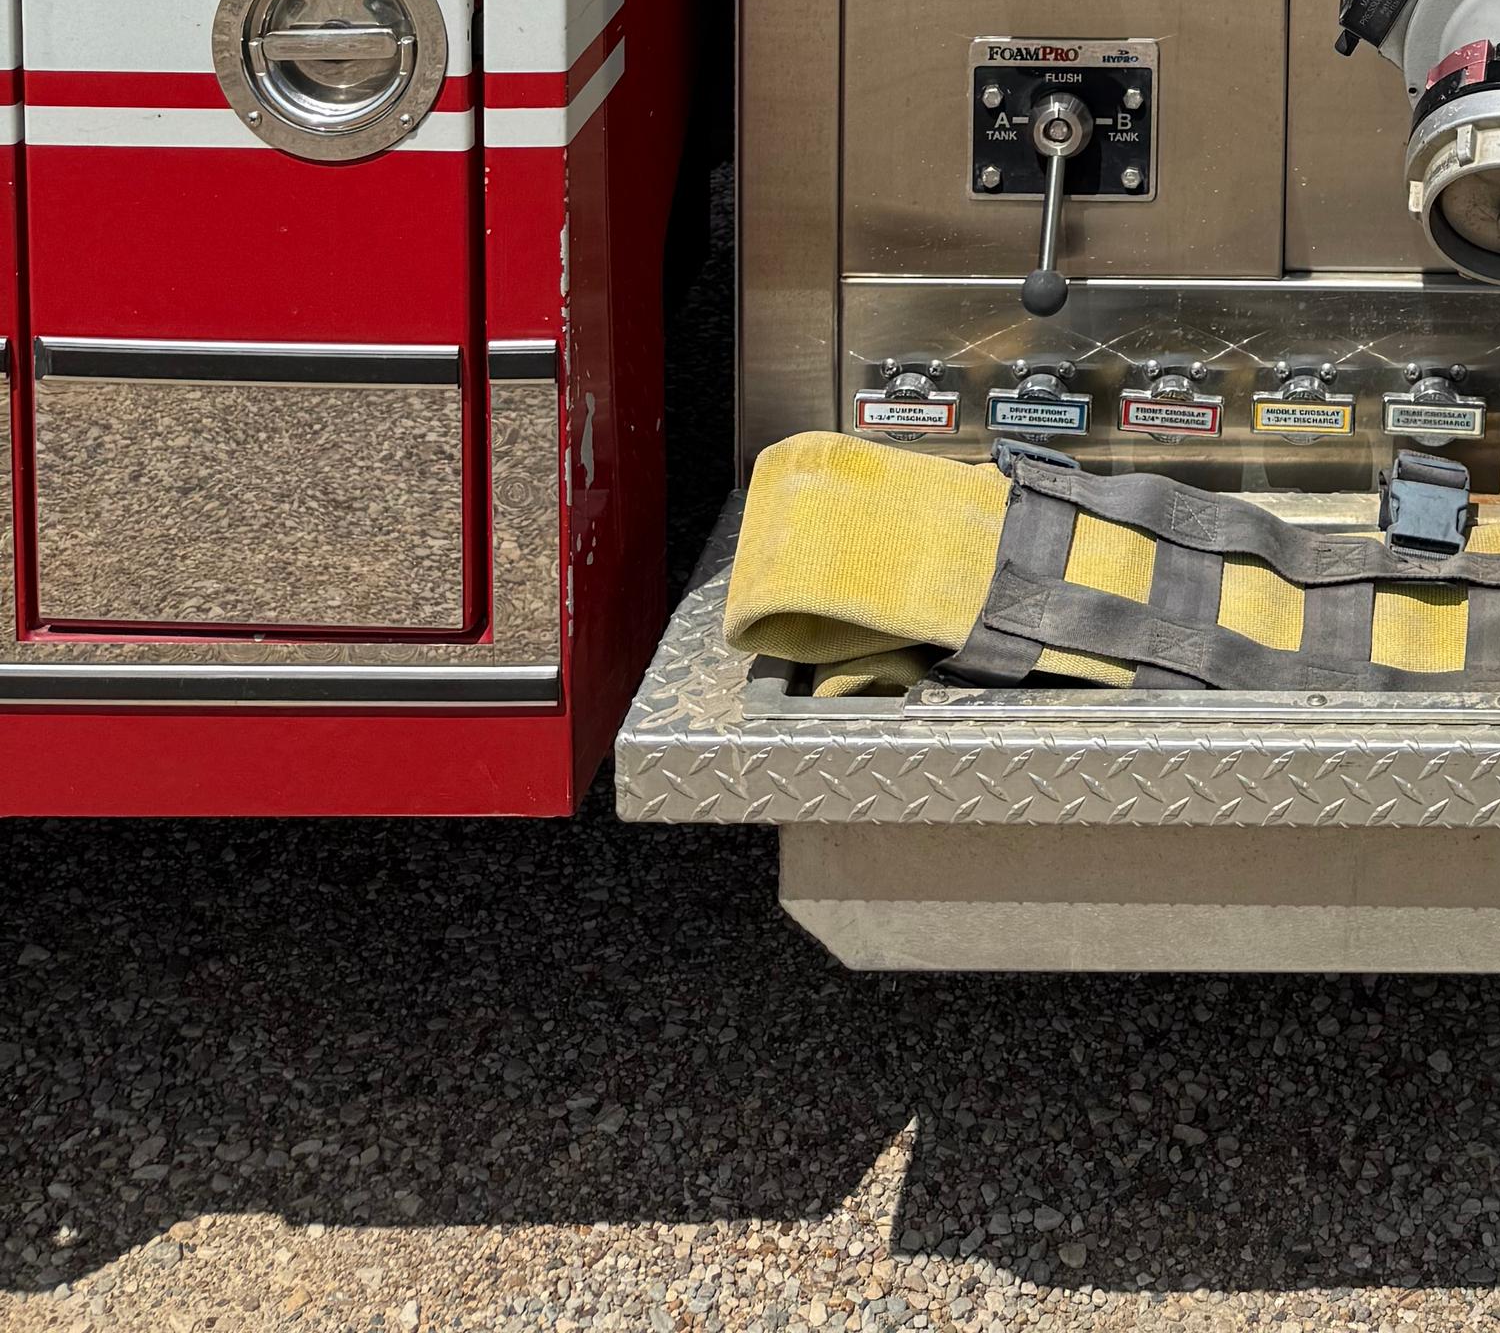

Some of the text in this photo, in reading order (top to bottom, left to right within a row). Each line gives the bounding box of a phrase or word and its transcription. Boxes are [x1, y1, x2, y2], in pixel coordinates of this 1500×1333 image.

[988, 45, 1139, 63] FOAMPRO HYPRO
[1045, 73, 1083, 83] FLUSH
[994, 111, 1011, 129] A
[1117, 113, 1132, 130] B
[986, 130, 1017, 141] TANK
[1108, 132, 1139, 142] TANK
[889, 407, 925, 415] BUMPER
[1009, 407, 1068, 416] DRIVER FRONT
[1135, 407, 1207, 418] FRONT CROSSLAY
[1266, 408, 1341, 417] MIDDLE CROSSLAY
[1424, 411, 1468, 419] CROSSLAY
[896, 414, 944, 423] DISCHARGE
[1028, 415, 1076, 425] DISCHARGE
[1161, 416, 1208, 426] DISCHARGE
[1293, 417, 1340, 425] DISCHARGE
[1423, 418, 1472, 427] DISCHARGE
